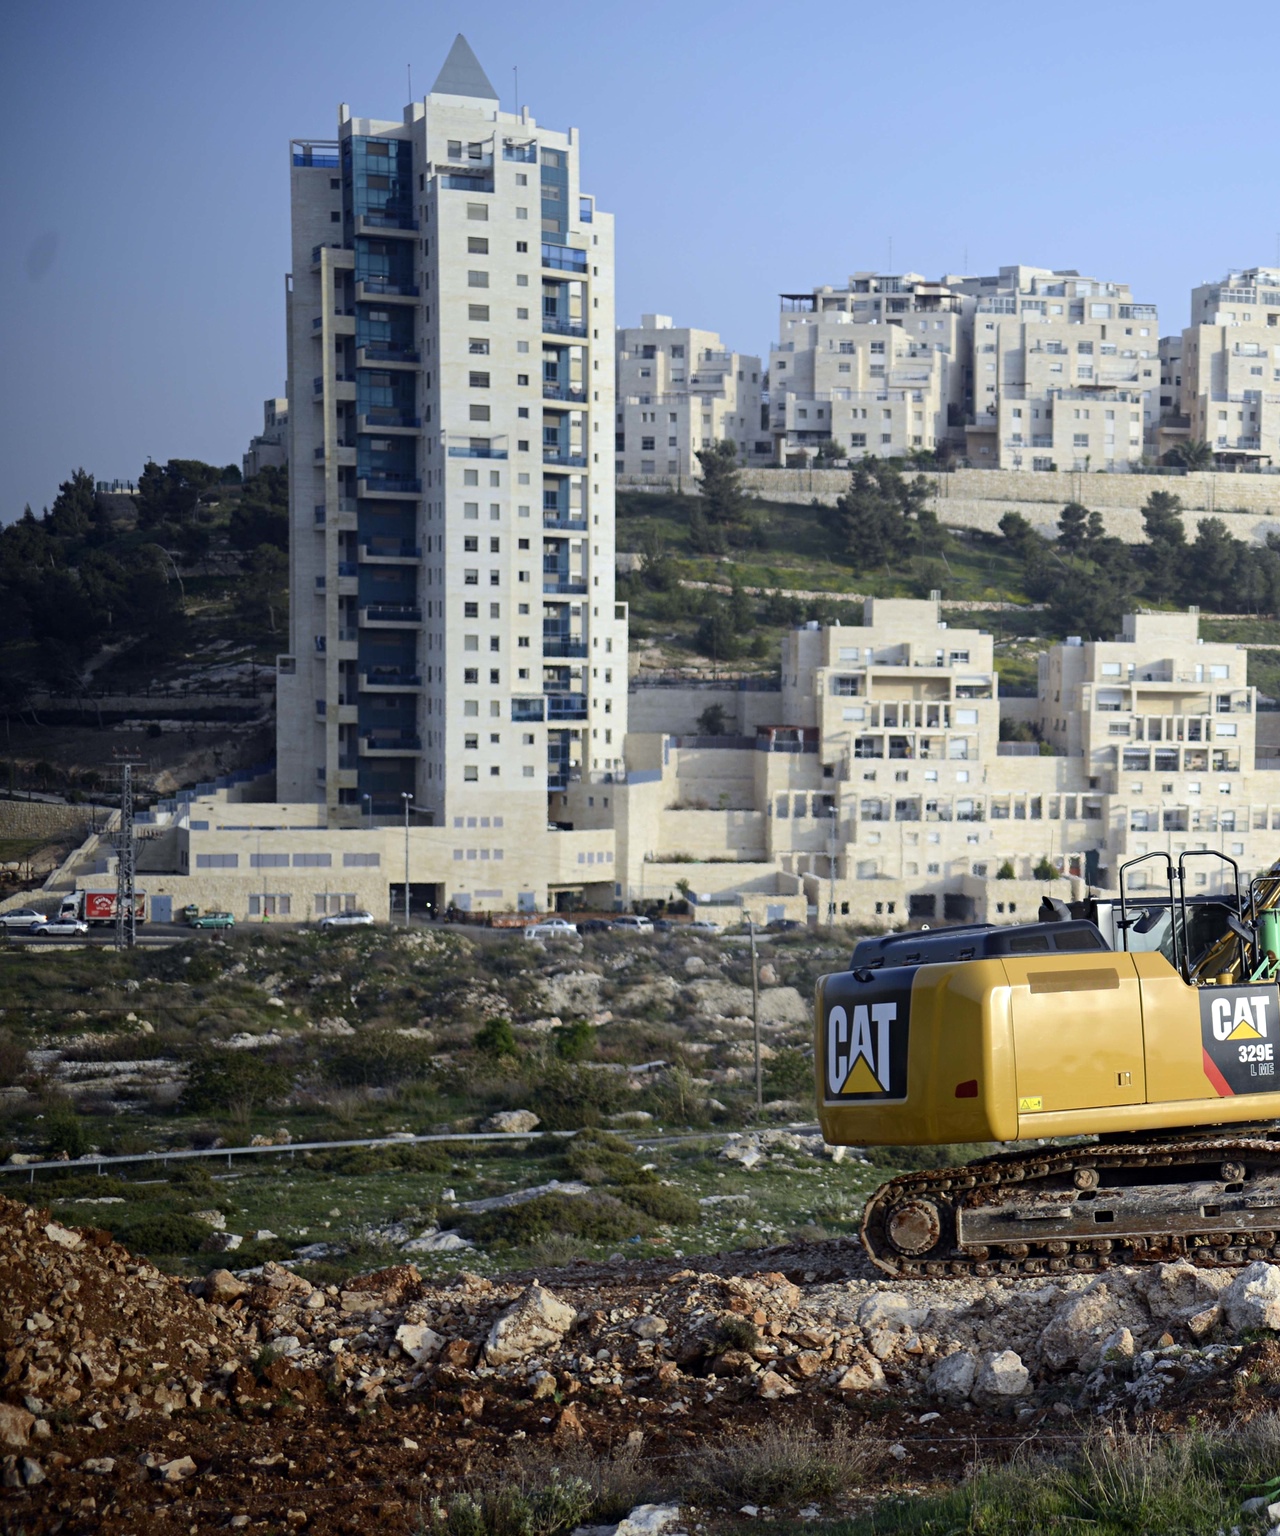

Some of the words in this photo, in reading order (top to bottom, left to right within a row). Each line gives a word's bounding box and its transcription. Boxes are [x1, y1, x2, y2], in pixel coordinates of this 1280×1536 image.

[1211, 995, 1270, 1041] CAT
[828, 1002, 897, 1094] CAT
[1238, 1043, 1274, 1063] 329E
[1250, 1063, 1257, 1077] L
[1258, 1062, 1275, 1076] ME
